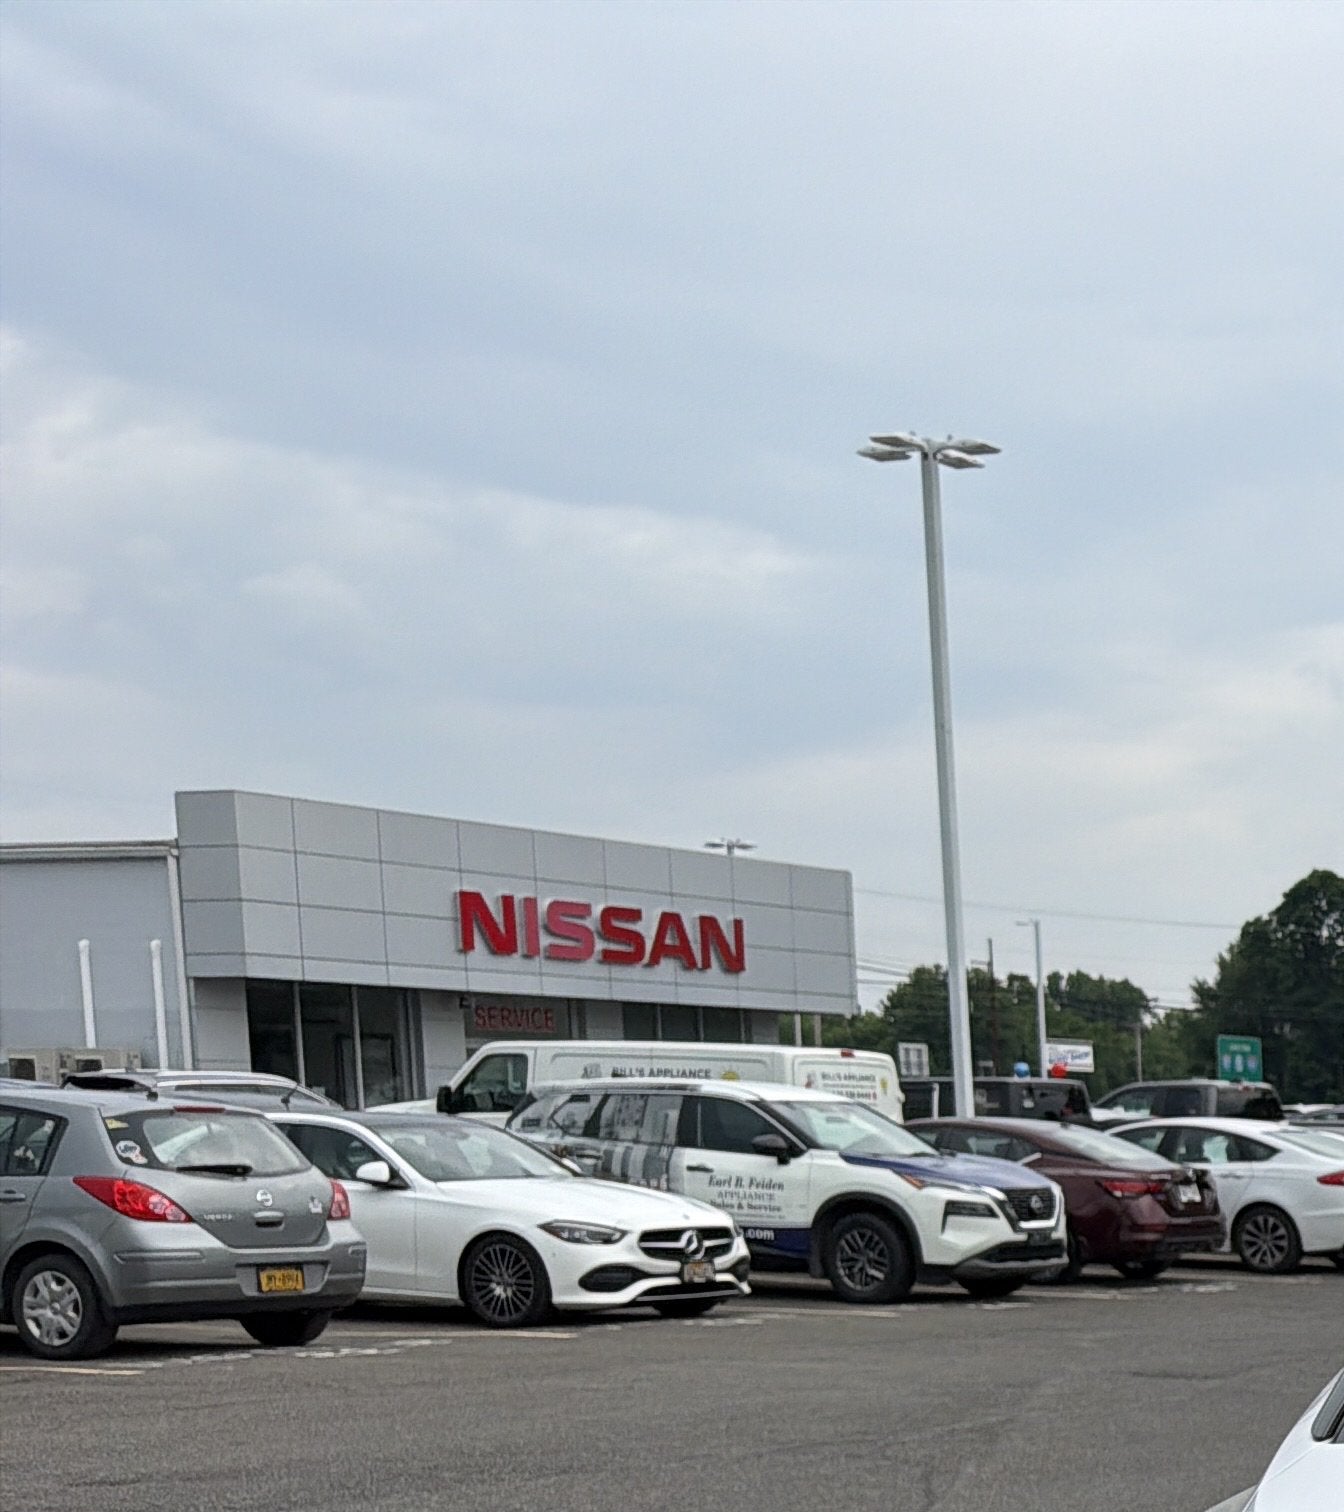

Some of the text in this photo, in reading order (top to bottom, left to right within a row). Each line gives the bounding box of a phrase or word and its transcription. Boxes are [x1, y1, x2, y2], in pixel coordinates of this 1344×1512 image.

[457, 889, 747, 974] NISSAN
[474, 1006, 556, 1033] SERVICE
[648, 1067, 712, 1080] APPLIANCE
[708, 1175, 733, 1188] Earl
[717, 1190, 776, 1201] APPLIANCE
